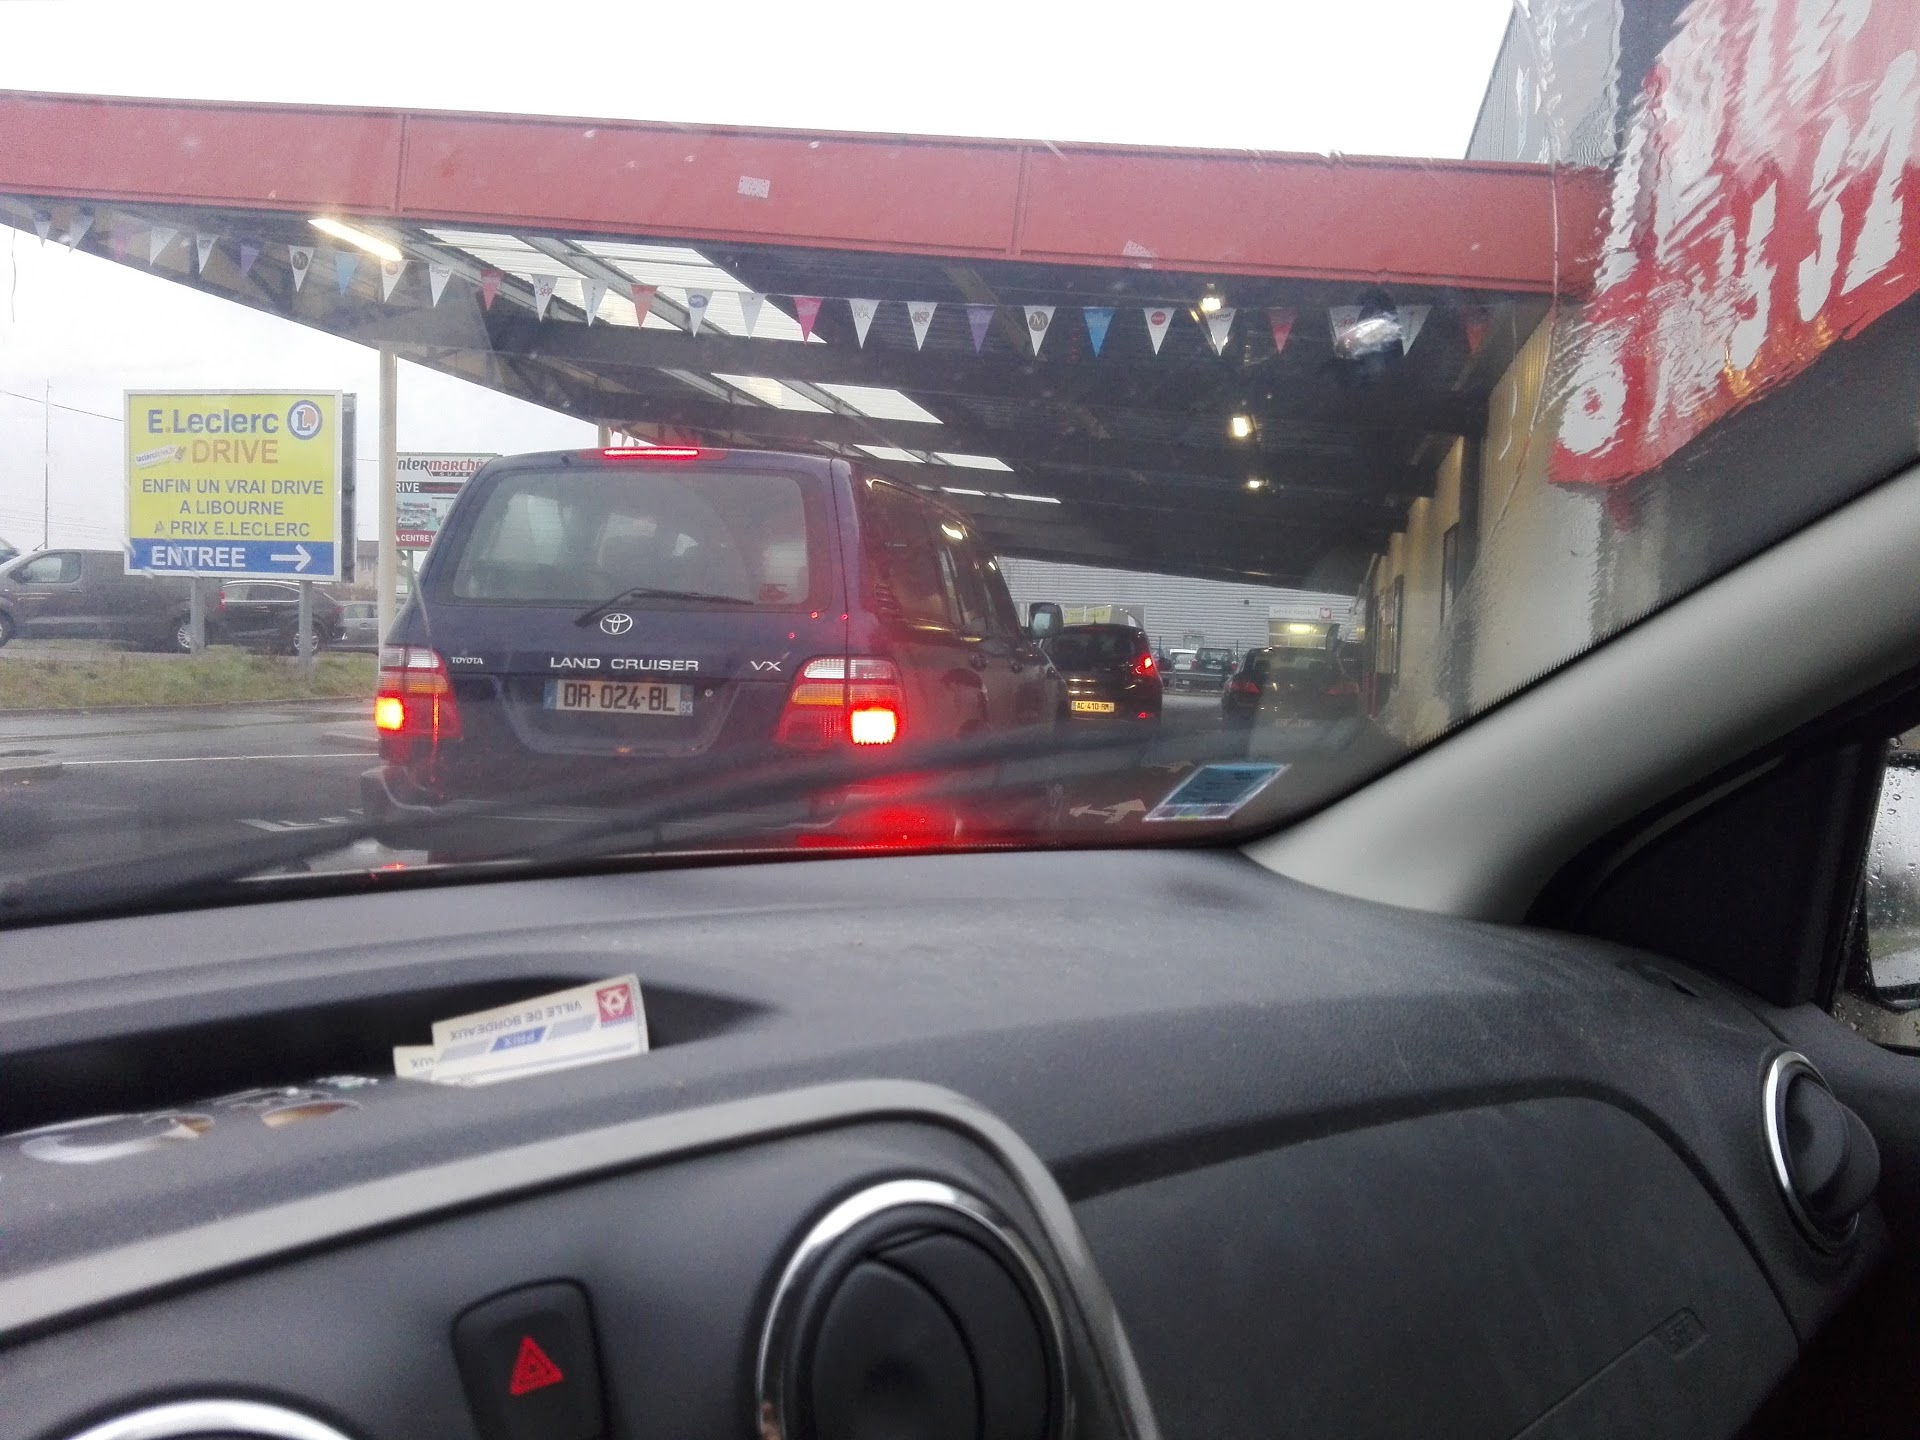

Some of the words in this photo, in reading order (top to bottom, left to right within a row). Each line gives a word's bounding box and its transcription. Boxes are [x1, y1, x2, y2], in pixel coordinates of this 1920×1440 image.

[147, 408, 279, 434] E.Leclerc
[191, 439, 279, 464] DRIVE
[142, 478, 191, 493] ENFIN
[196, 479, 220, 494] UN
[226, 480, 266, 494] VRAI
[271, 480, 324, 495] DRIVE
[396, 481, 420, 493] RIVE
[179, 500, 192, 514] A
[196, 500, 284, 515] LIBOURNE
[170, 521, 208, 535] PRIX
[214, 521, 311, 537] E.LECLERC
[401, 534, 429, 542] CENTRE
[151, 545, 246, 568] ENTREE
[451, 656, 484, 665] TOYOTA
[549, 657, 600, 670] LAND
[611, 658, 699, 672] CRUISER
[750, 660, 782, 673] VX
[680, 702, 693, 713] 83
[525, 1010, 544, 1022] DE
[546, 1000, 582, 1017] VILLE
[450, 1012, 523, 1041] BORDEAUX
[504, 1030, 537, 1047] PRIX
